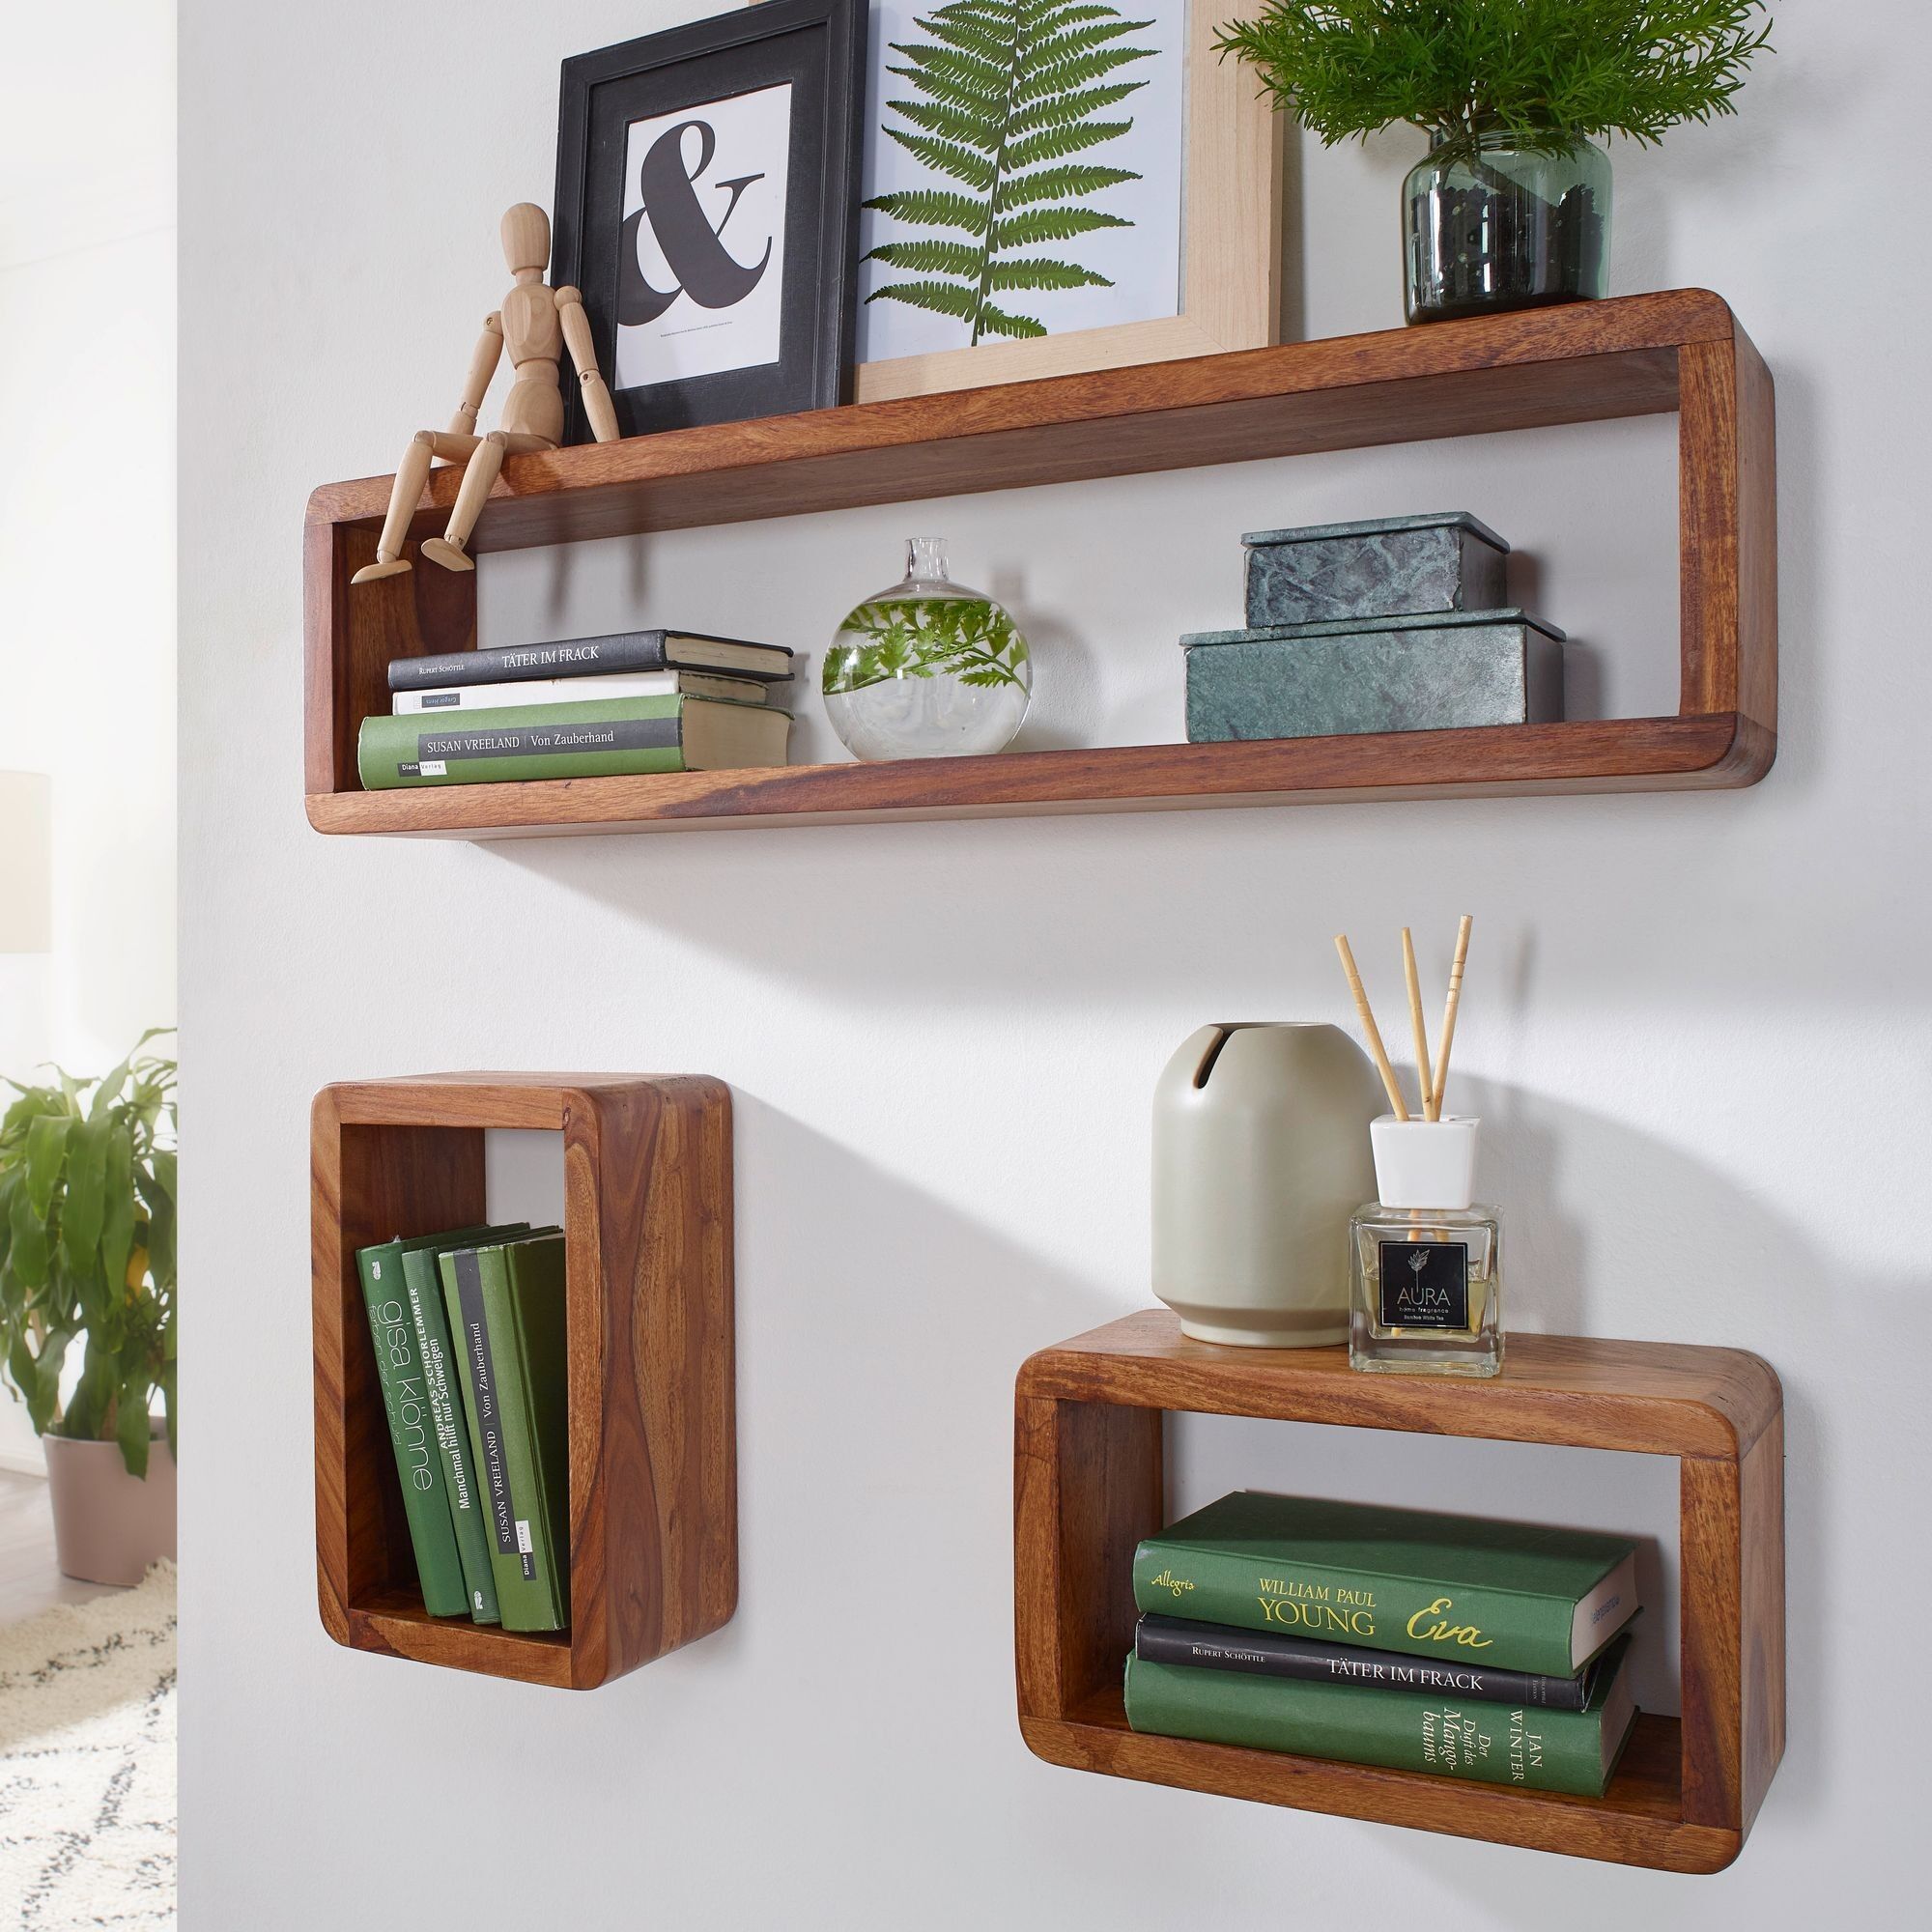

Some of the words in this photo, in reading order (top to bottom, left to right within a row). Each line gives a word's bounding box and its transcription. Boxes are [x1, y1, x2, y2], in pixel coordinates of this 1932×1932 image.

[617, 120, 772, 327] &
[418, 667, 438, 675] RUPERT
[502, 652, 539, 668] TÄTER
[540, 650, 556, 665] IM
[558, 645, 600, 663] FRACK
[427, 740, 462, 753] SUSAN
[464, 736, 520, 751] VREELAND
[531, 734, 551, 747] Von
[554, 730, 614, 745] Zauberhand
[1396, 1286, 1451, 1306] AURA
[410, 1288, 436, 1385] SCHORLEMMER
[369, 1304, 384, 1355] farben
[380, 1360, 390, 1387] der
[386, 1392, 402, 1445] schuld
[429, 1338, 449, 1400] Schweigen
[470, 1322, 489, 1391] Zauberhand
[377, 1300, 412, 1370] gisa
[396, 1377, 433, 1491] klönne
[441, 1402, 453, 1422] nur
[483, 1395, 492, 1418] Von
[430, 1389, 449, 1449] ANDREAS
[444, 1423, 459, 1448] hilft
[448, 1449, 470, 1509] Manchmal
[487, 1431, 503, 1497] VREELAND
[497, 1501, 511, 1543] SUSAN
[1151, 1569, 1195, 1597] Allegria
[1259, 1577, 1329, 1601] WILLIAM
[1337, 1588, 1377, 1607] PAUL
[1258, 1597, 1376, 1635] YOUNG
[1406, 1598, 1493, 1648] Eva
[1192, 1646, 1223, 1658] RUPERT
[1225, 1650, 1266, 1663] SCHÖTTLE
[1326, 1657, 1384, 1680] TÄTER
[1390, 1666, 1415, 1683] IM
[1419, 1669, 1484, 1690] FRACK
[1422, 1711, 1441, 1763] baums
[1437, 1706, 1462, 1771] Mango-
[1460, 1719, 1477, 1748] Duft
[1478, 1733, 1492, 1758] Der
[1510, 1709, 1525, 1781] WINTER
[1526, 1731, 1543, 1768] JAN
[1463, 1749, 1477, 1766] des
